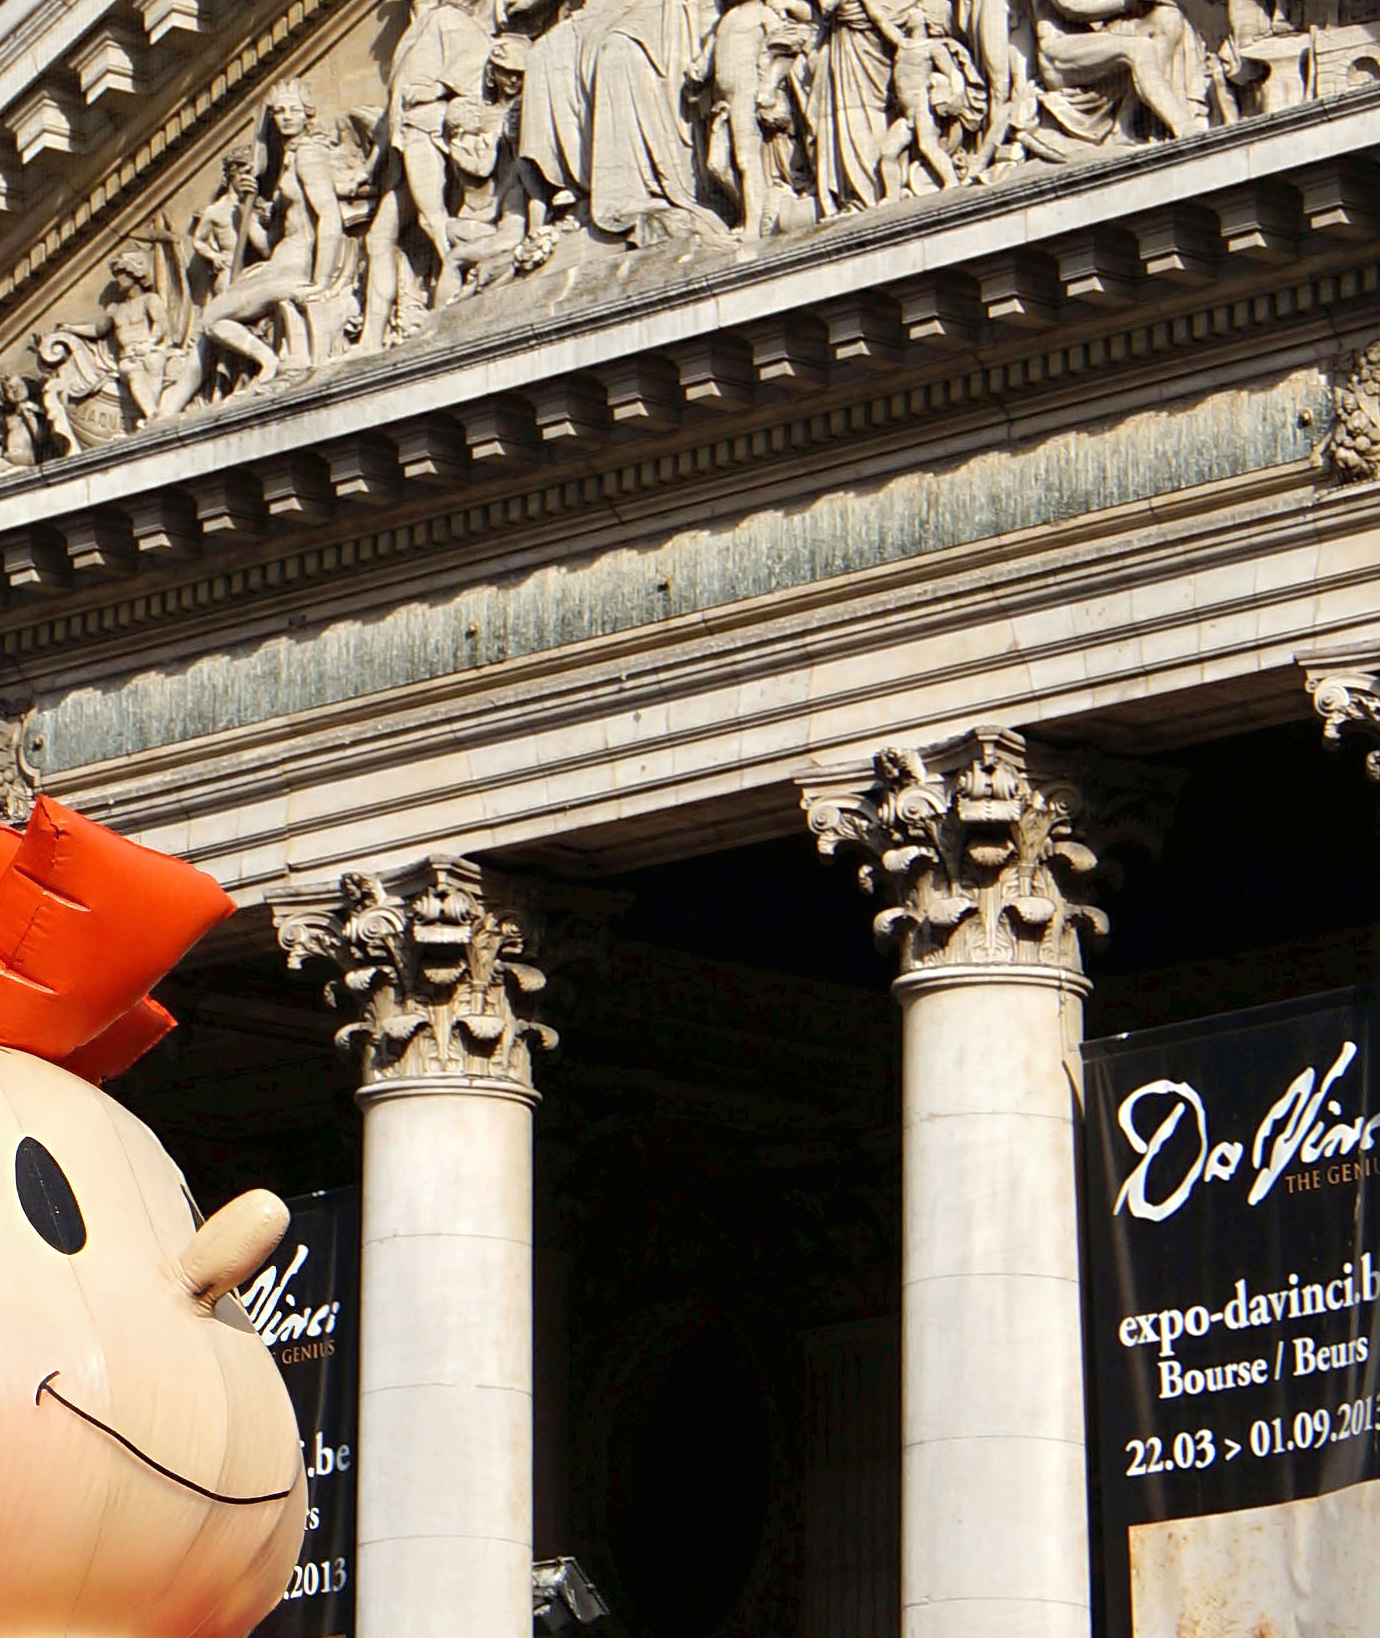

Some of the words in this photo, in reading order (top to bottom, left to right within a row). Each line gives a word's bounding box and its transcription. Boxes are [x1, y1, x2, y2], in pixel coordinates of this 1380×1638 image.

[1284, 1169, 1322, 1194] THE
[281, 1338, 336, 1365] GENIUS
[1156, 1359, 1269, 1400] Bourse
[1291, 1335, 1369, 1377] Beurs
[1124, 1427, 1217, 1477] 22.03
